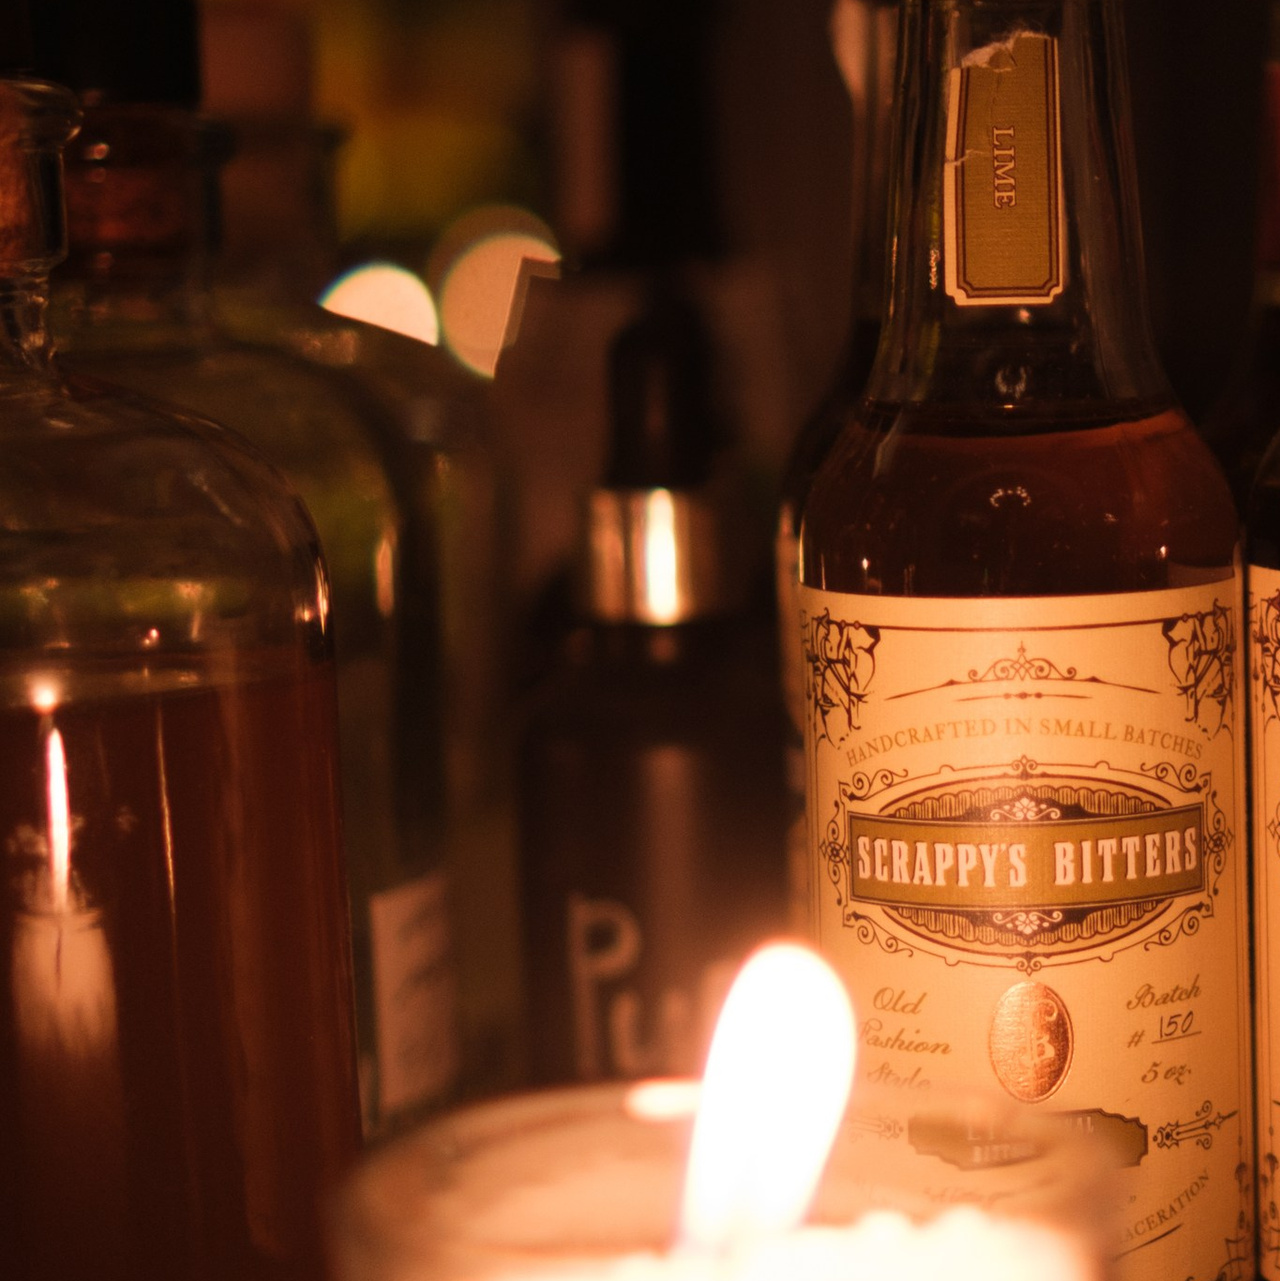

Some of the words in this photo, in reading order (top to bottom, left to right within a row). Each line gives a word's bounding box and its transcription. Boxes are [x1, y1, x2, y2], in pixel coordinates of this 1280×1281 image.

[992, 125, 1017, 210] LIME
[845, 717, 997, 768] HANDCRAFTED
[1004, 716, 1032, 736] IN
[1039, 717, 1118, 740] SMALL
[1123, 723, 1203, 761] BATCHES
[857, 835, 1028, 888] SCRAPPY'S
[1053, 826, 1198, 886] BITTERS
[872, 986, 928, 1016] Old
[1125, 972, 1202, 1011] Batch
[1125, 1028, 1146, 1049] #
[1158, 1010, 1196, 1039] 150
[866, 1060, 932, 1092] Style
[1140, 1062, 1160, 1085] 5
[1123, 1166, 1210, 1241] ACERATION
